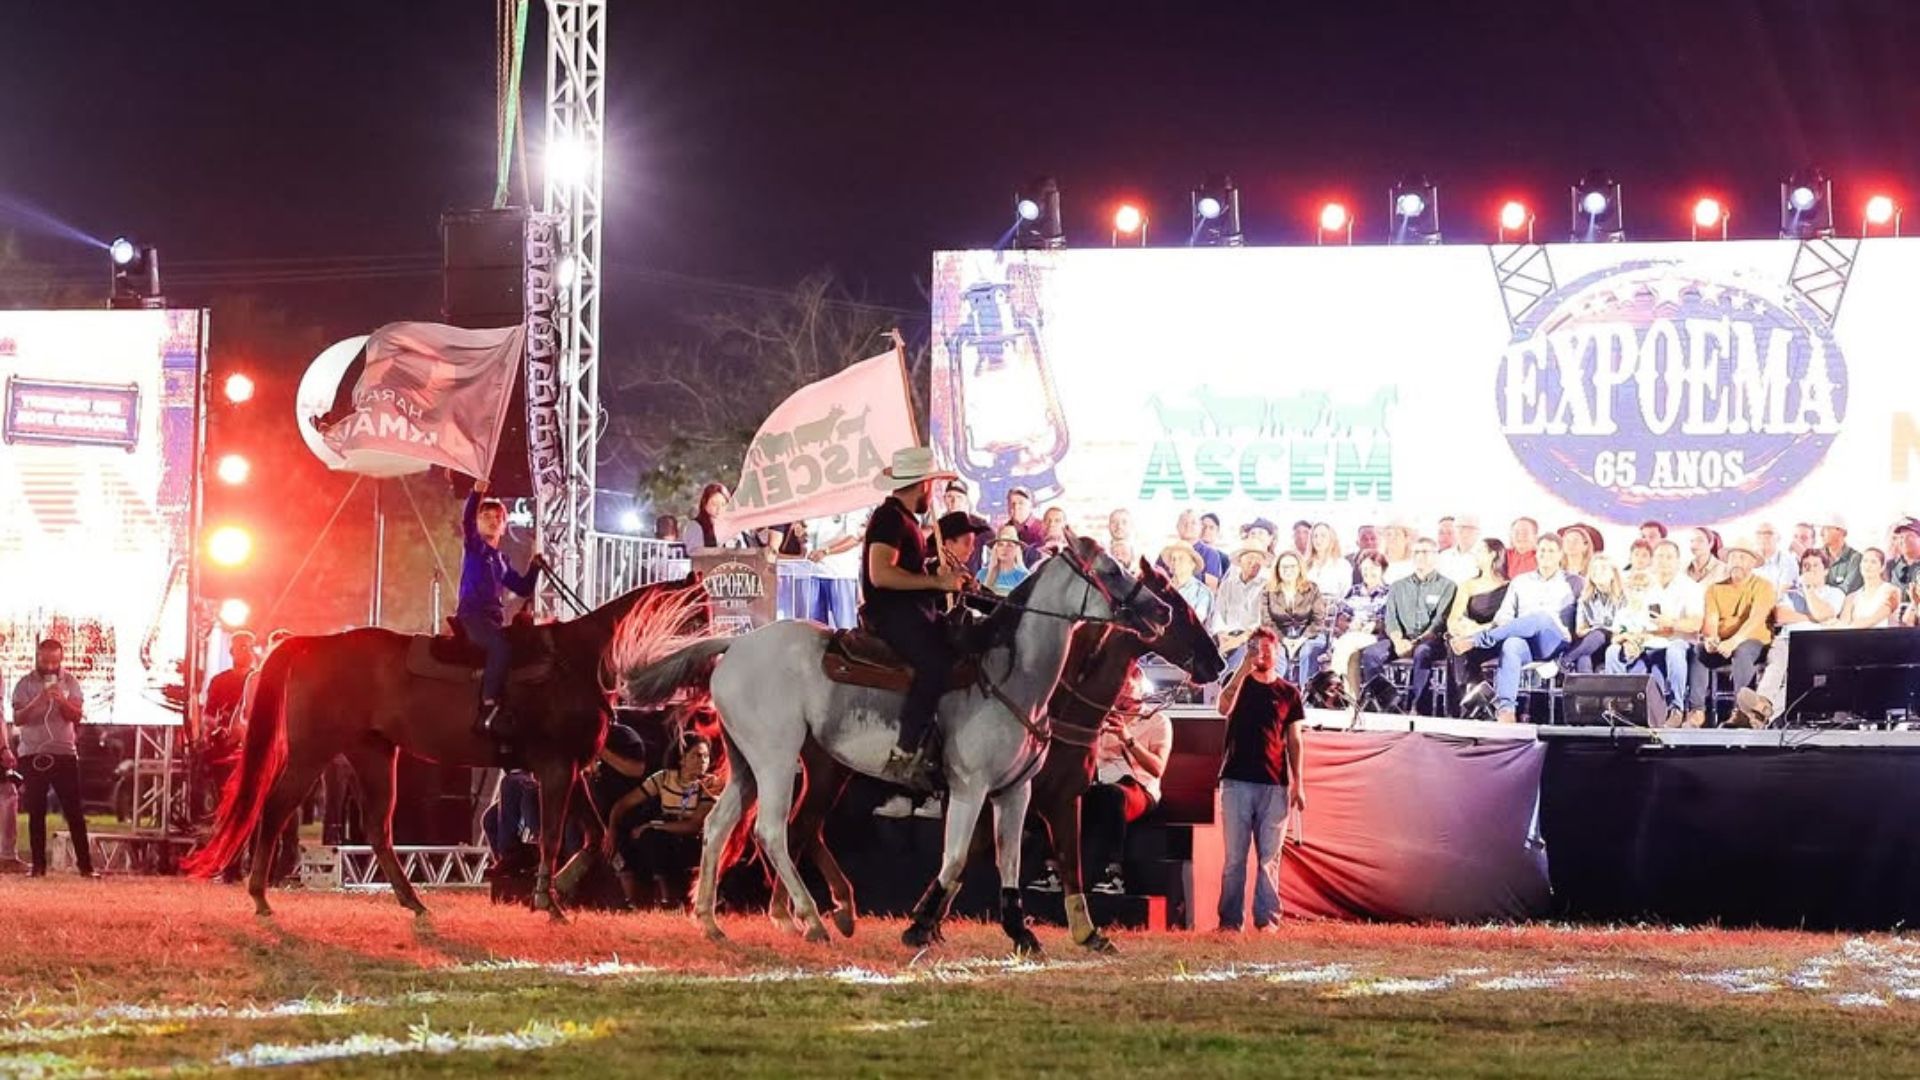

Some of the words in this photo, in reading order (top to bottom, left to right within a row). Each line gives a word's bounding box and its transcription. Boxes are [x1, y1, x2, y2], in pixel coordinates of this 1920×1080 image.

[1499, 317, 1842, 436] EXPOEMA
[1138, 440, 1393, 501] ASCEM
[1593, 450, 1637, 488] 65
[1649, 450, 1746, 488] ANOS
